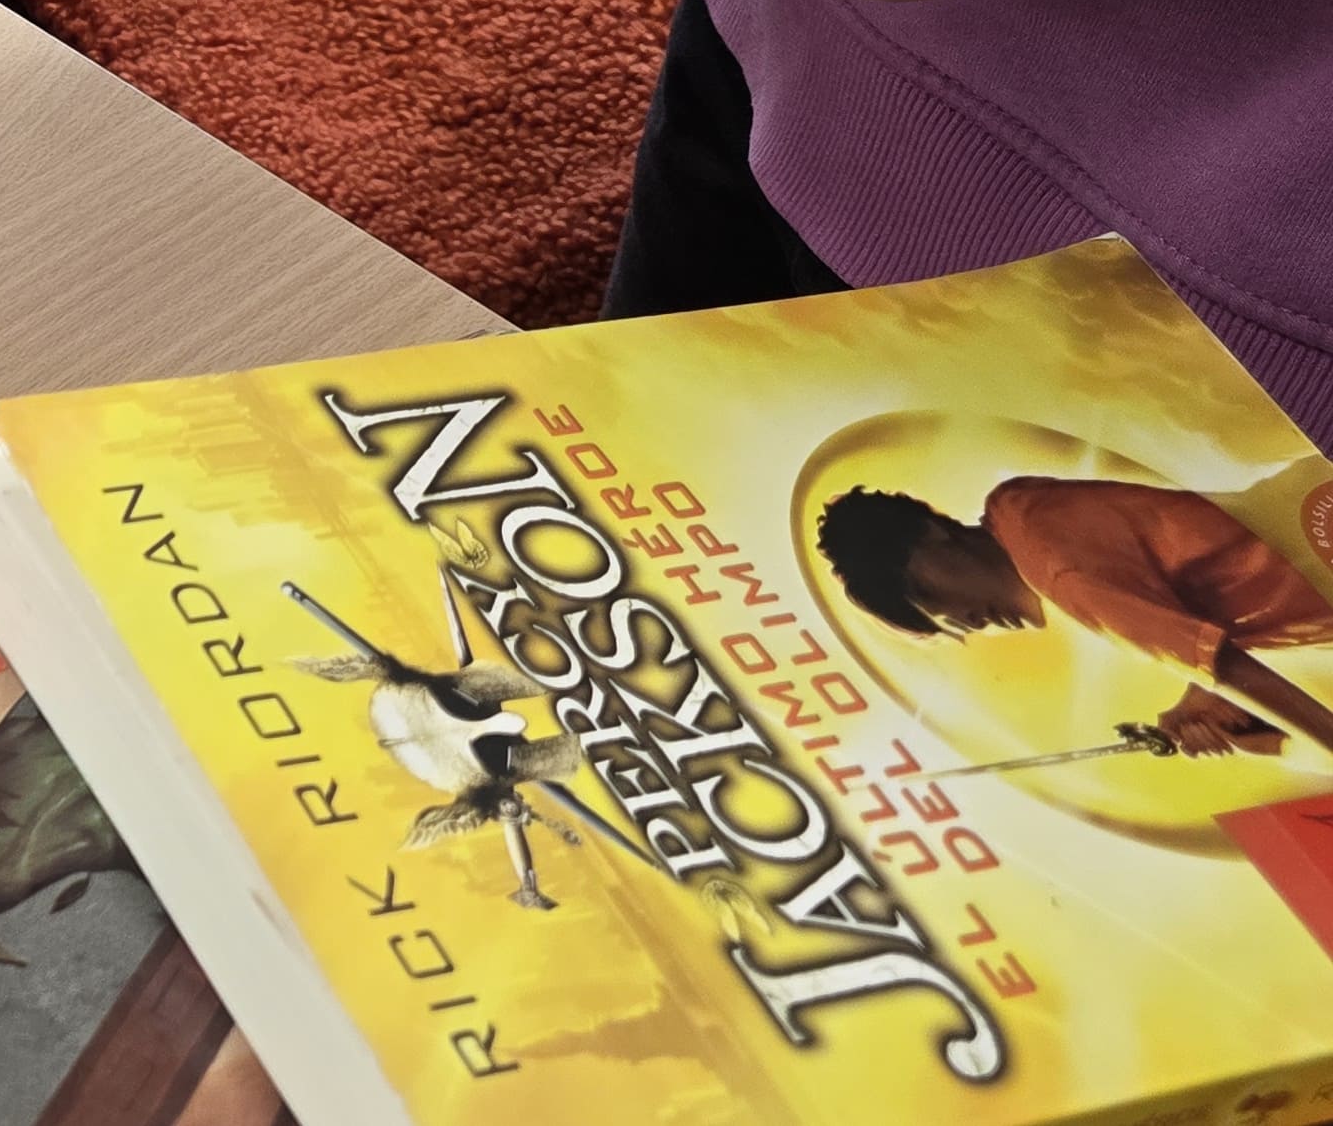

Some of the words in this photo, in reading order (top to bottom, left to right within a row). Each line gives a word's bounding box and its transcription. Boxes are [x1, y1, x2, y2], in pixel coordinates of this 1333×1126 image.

[533, 403, 721, 606] HÉROE
[653, 480, 868, 715] OLIMPO
[102, 482, 359, 828] RIORDAN
[323, 390, 1003, 1079] JACKSON
[445, 564, 734, 880] PERCY
[722, 631, 940, 877] ÚLTIMO
[891, 738, 1001, 874] DEL
[346, 865, 522, 1078] RICK
[959, 903, 1036, 999] EL
